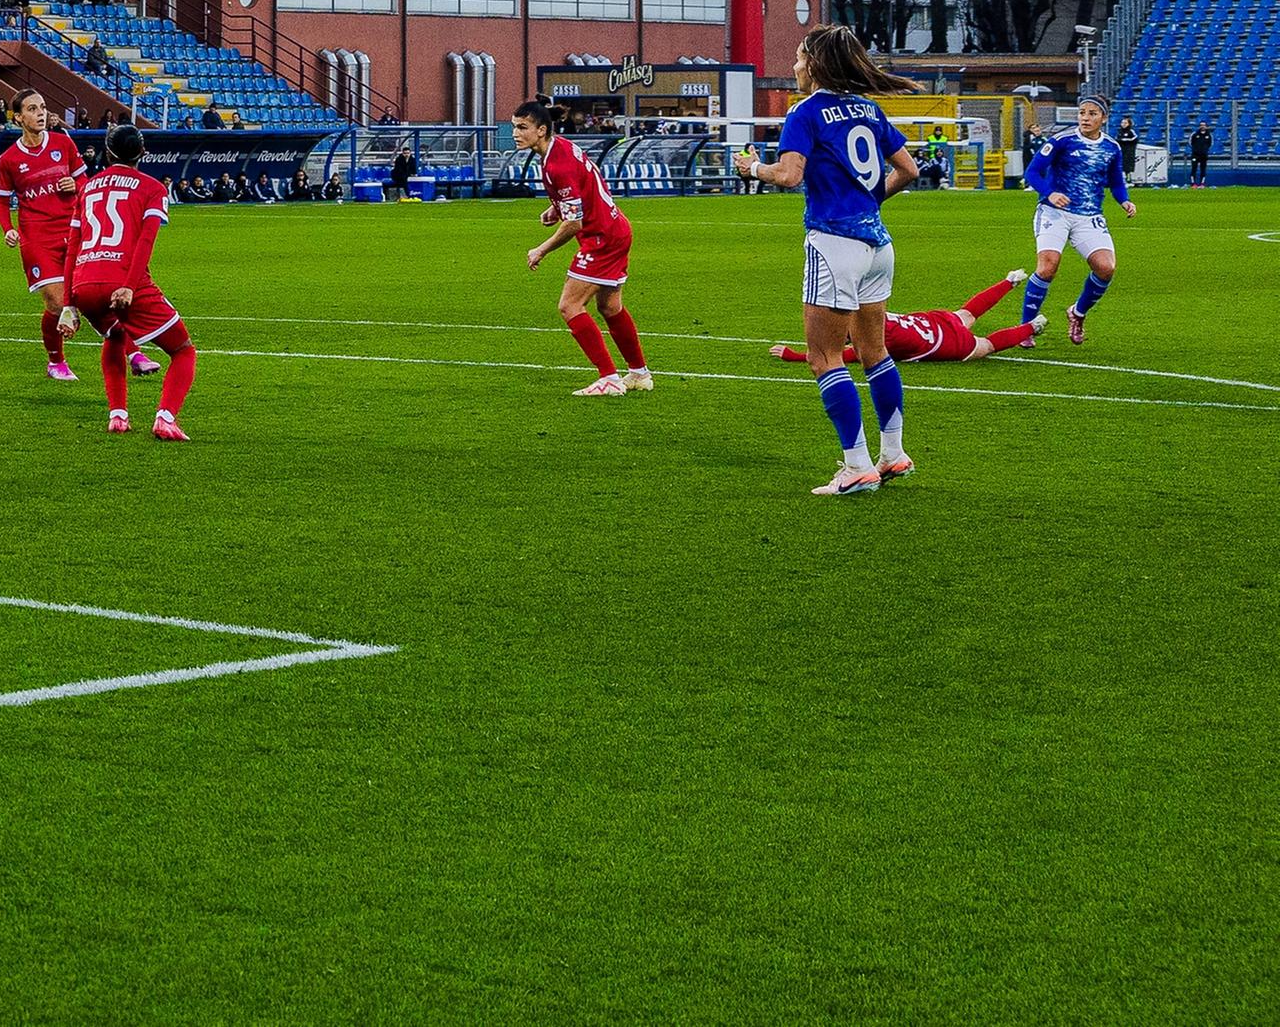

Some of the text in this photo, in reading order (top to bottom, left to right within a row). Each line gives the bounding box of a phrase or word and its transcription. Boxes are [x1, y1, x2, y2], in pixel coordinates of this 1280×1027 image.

[623, 56, 635, 70] LA
[553, 85, 580, 95] CASSA
[681, 85, 709, 95] CASSA
[822, 103, 880, 124] DEL ESTAL
[139, 150, 179, 163] Revolut
[198, 150, 239, 163] Revolut
[257, 149, 298, 162] Revolut
[847, 125, 880, 191] 9
[109, 174, 140, 190] PINDO
[25, 183, 62, 199] MARL
[82, 190, 129, 250] 55
[1090, 215, 1107, 230] 18
